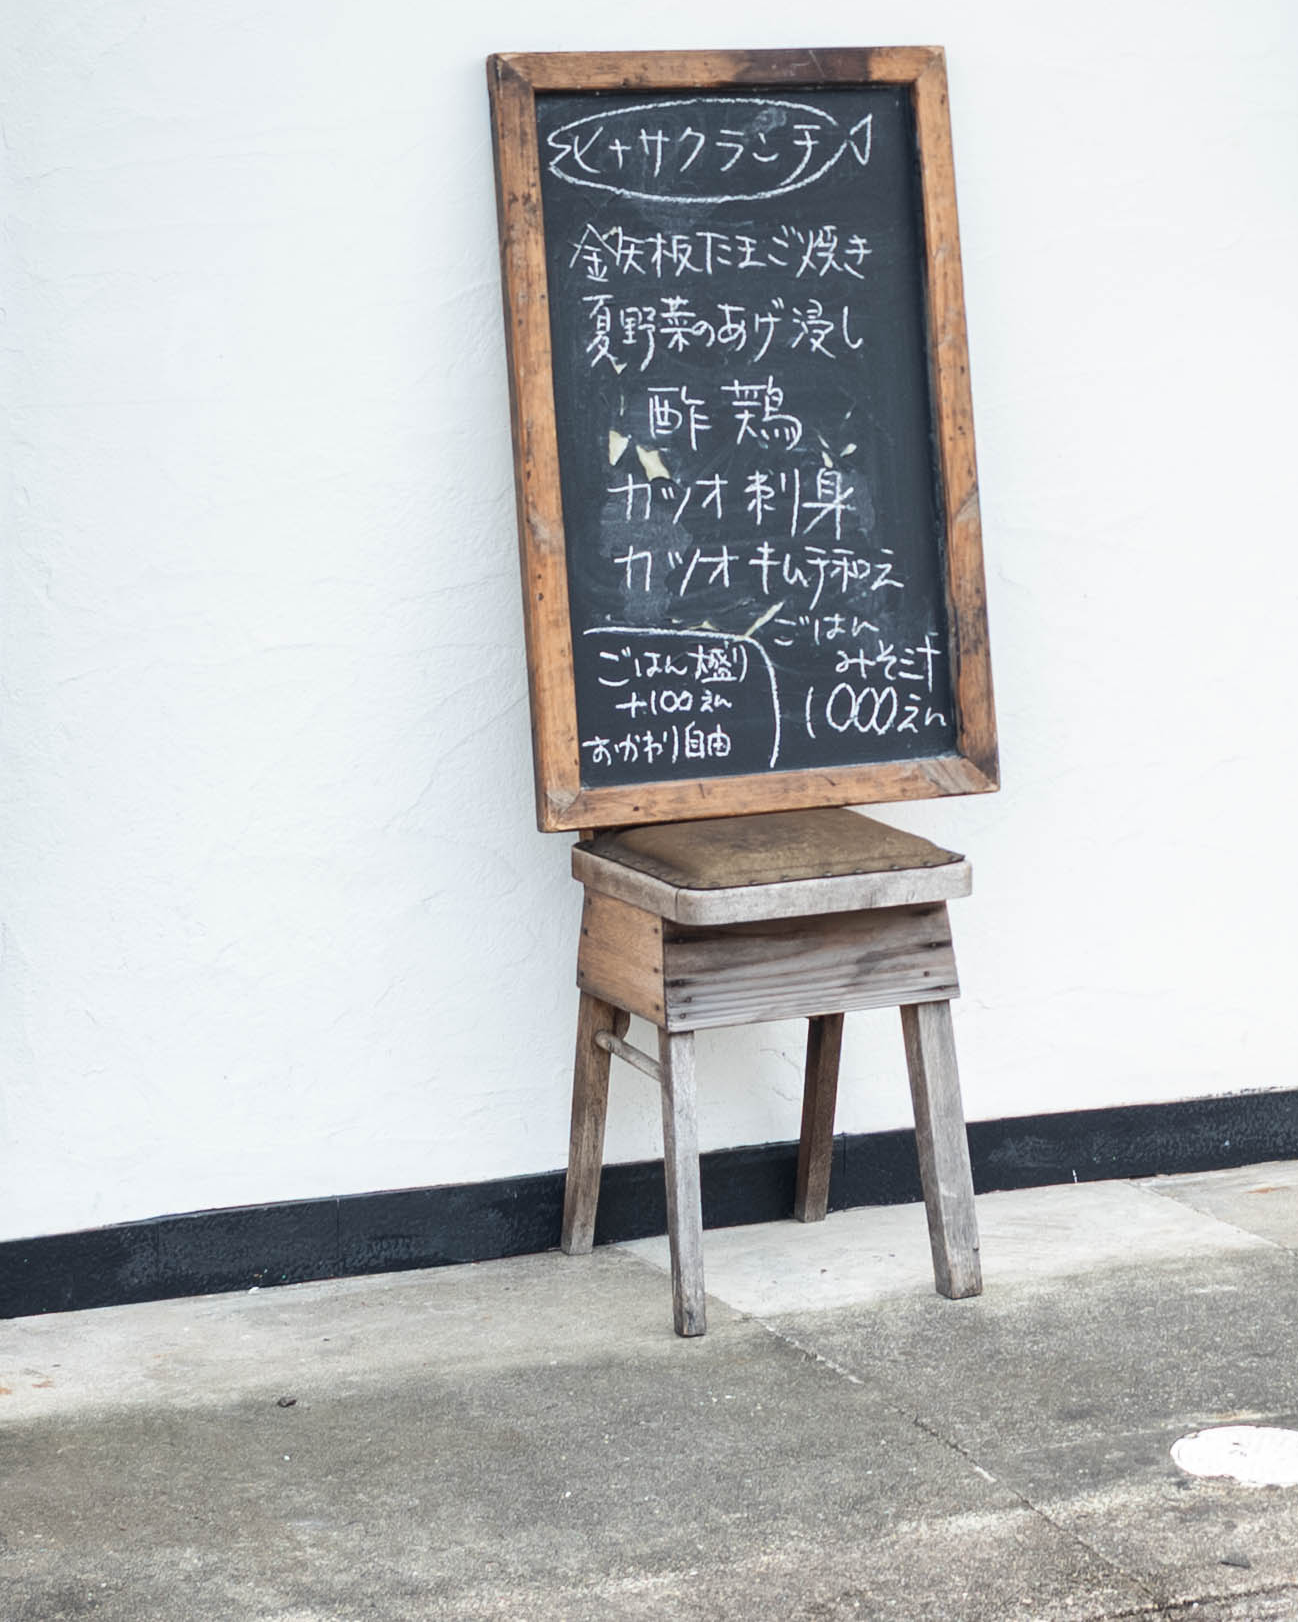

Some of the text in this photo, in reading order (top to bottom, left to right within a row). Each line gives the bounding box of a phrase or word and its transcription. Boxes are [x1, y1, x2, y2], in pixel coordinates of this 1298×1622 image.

[582, 294, 865, 372] 夏野菜のあげ浸し
[647, 375, 803, 451] 酢鶏
[581, 719, 732, 767] おかわり自由
